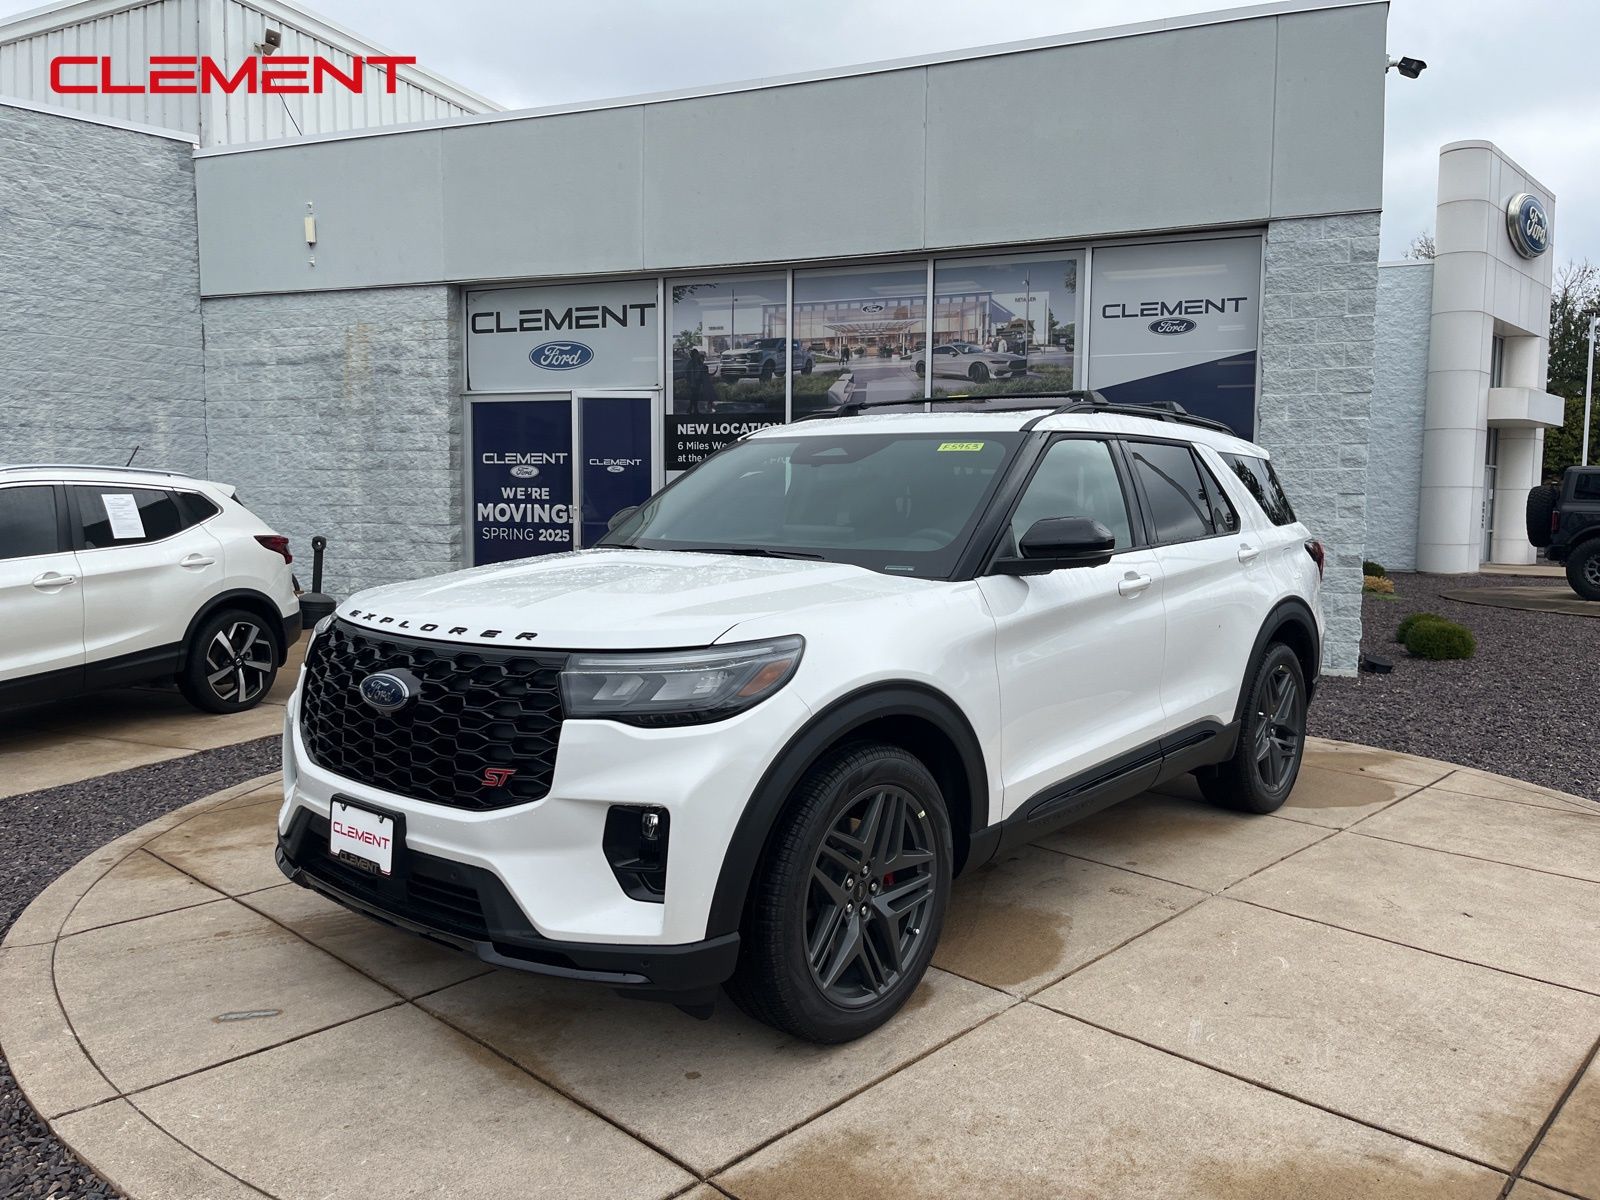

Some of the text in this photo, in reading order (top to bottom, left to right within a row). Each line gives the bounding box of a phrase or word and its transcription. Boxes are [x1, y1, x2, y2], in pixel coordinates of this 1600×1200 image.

[1526, 206, 1547, 245] Ford
[1102, 297, 1248, 319] CLEMENT
[471, 303, 656, 334] CLEMENT
[1156, 320, 1188, 333] Ford
[539, 345, 583, 366] Ford
[677, 423, 709, 435] NEW
[677, 441, 684, 450] 6
[686, 441, 710, 450] Miles
[482, 453, 568, 465] CLEMENT
[589, 458, 642, 466] CLEMENT
[677, 454, 686, 462] at
[688, 453, 702, 462] the
[515, 466, 533, 476] Ford
[501, 487, 550, 499] WE'RE
[477, 503, 573, 523] MOVING!
[482, 527, 570, 542] SPRING 2025
[349, 609, 538, 641] EXPLORER
[366, 679, 396, 702] Ford
[481, 767, 517, 787] ST
[333, 821, 391, 849] CLEMENT
[339, 850, 379, 874] CLEMENT
